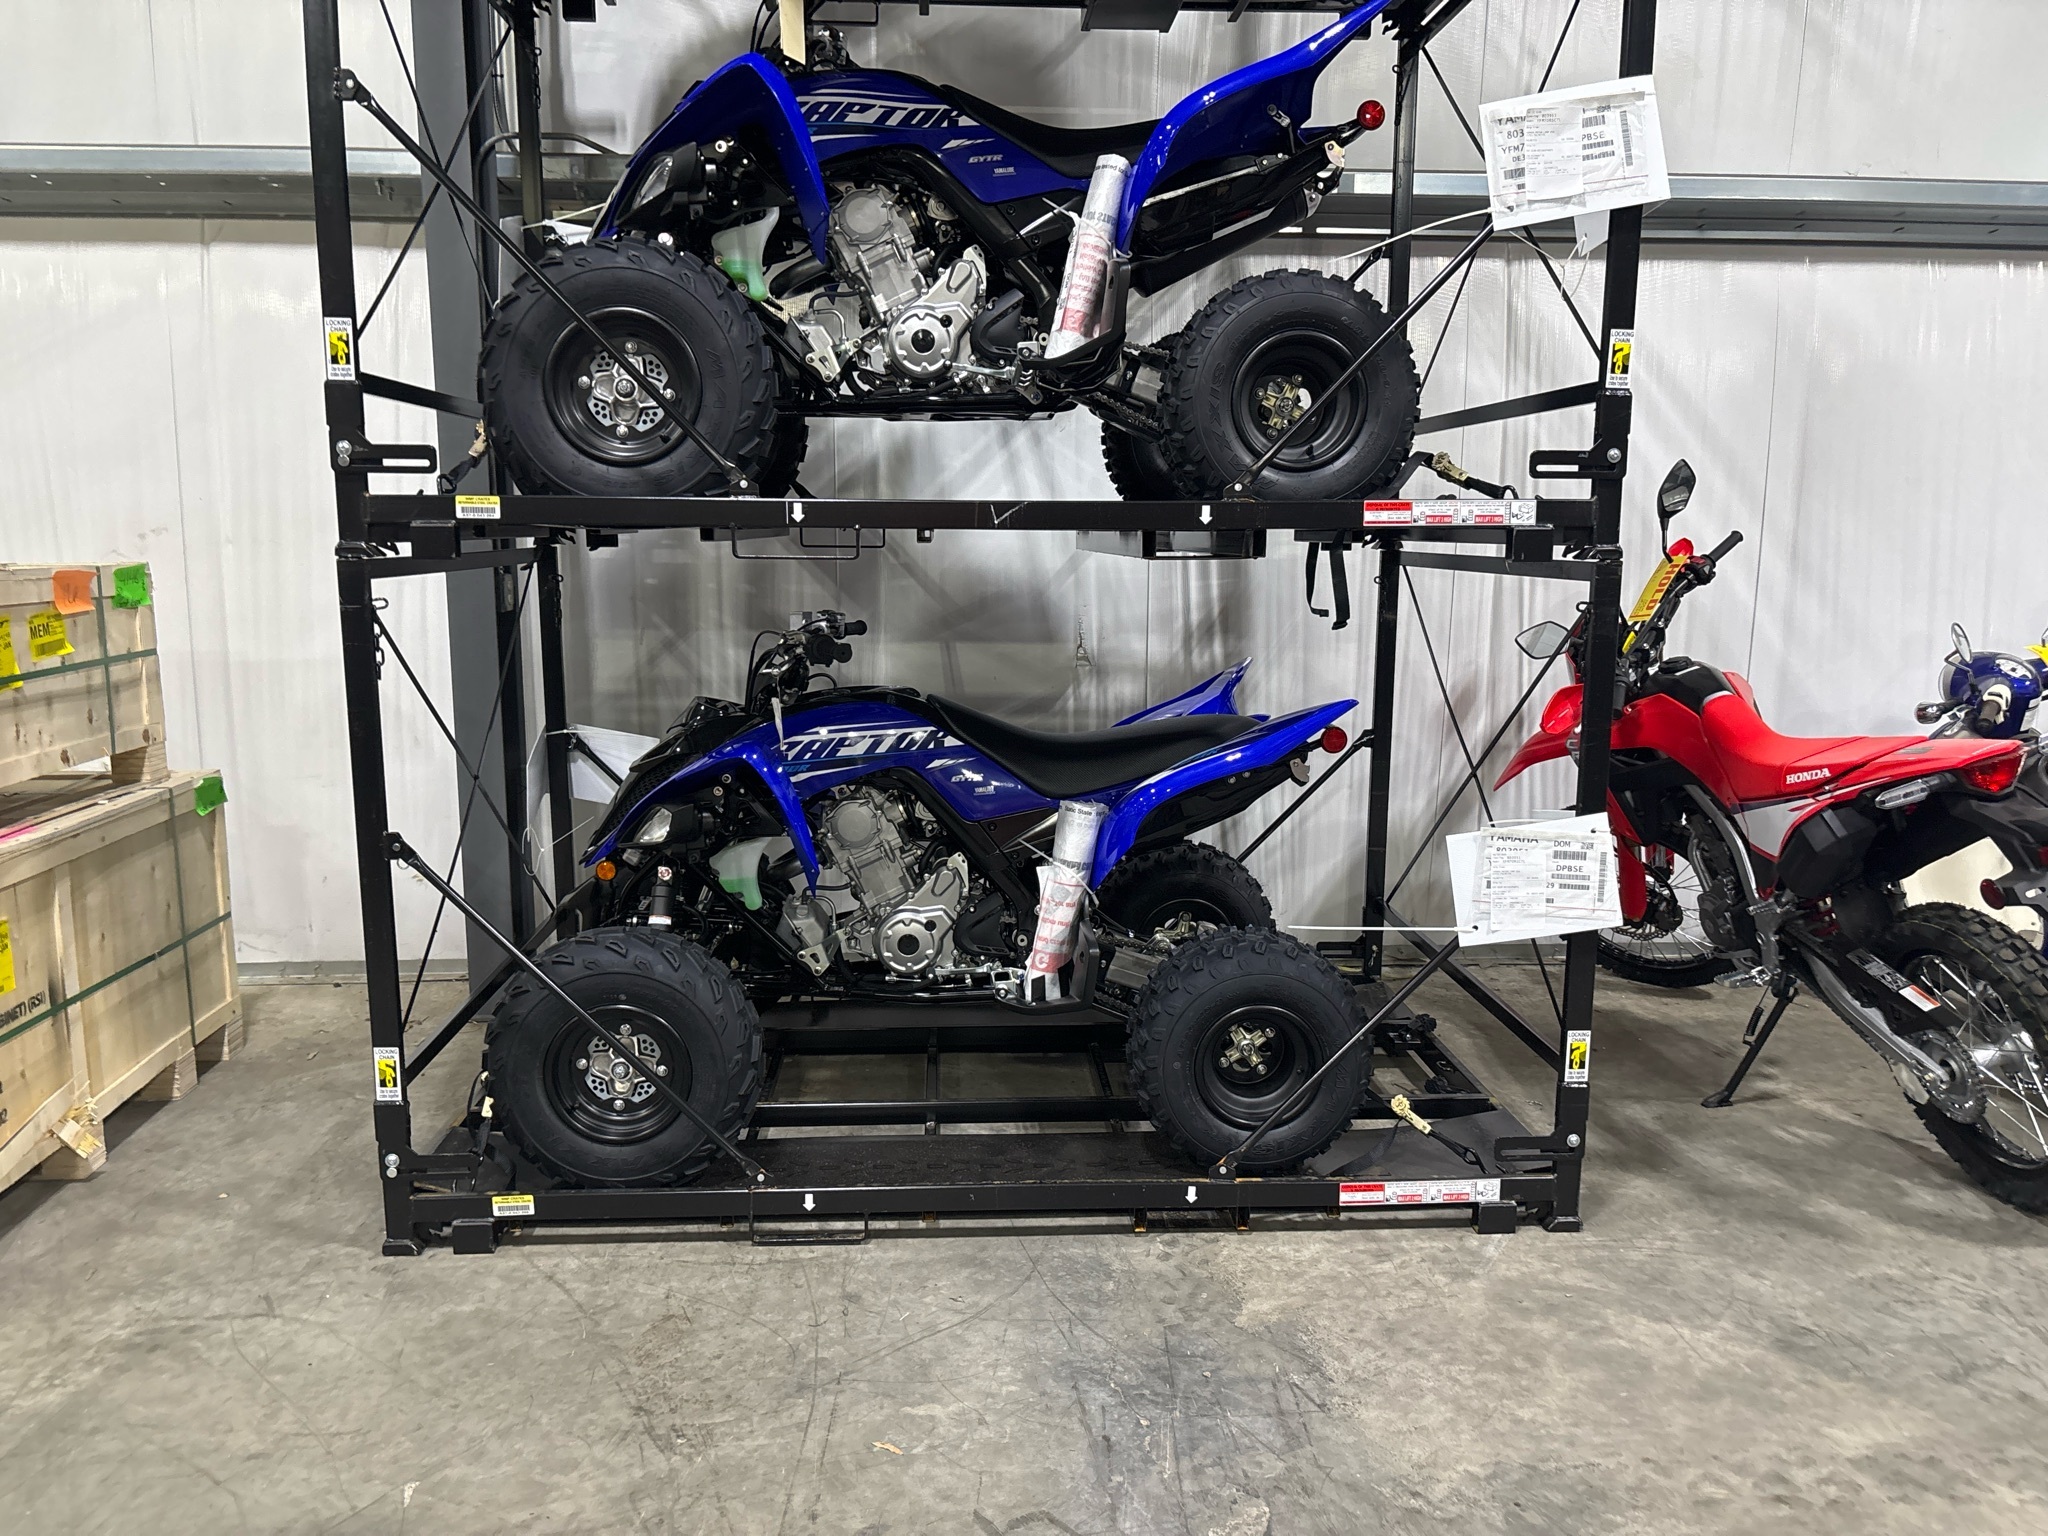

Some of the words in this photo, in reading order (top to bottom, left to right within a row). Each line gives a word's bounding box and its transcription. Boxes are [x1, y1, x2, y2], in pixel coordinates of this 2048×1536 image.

[802, 101, 962, 128] APTOR
[1507, 129, 1524, 140] 803
[1582, 131, 1606, 141] PBSE
[1501, 143, 1525, 155] YFM7
[967, 154, 1003, 164] GYTR
[1512, 154, 1526, 163] DE3
[1645, 563, 1681, 611] HOLD
[29, 622, 51, 641] MEM
[1785, 767, 1831, 785] HONDA
[1553, 840, 1571, 848] DOM
[1555, 864, 1584, 873] DPBSE
